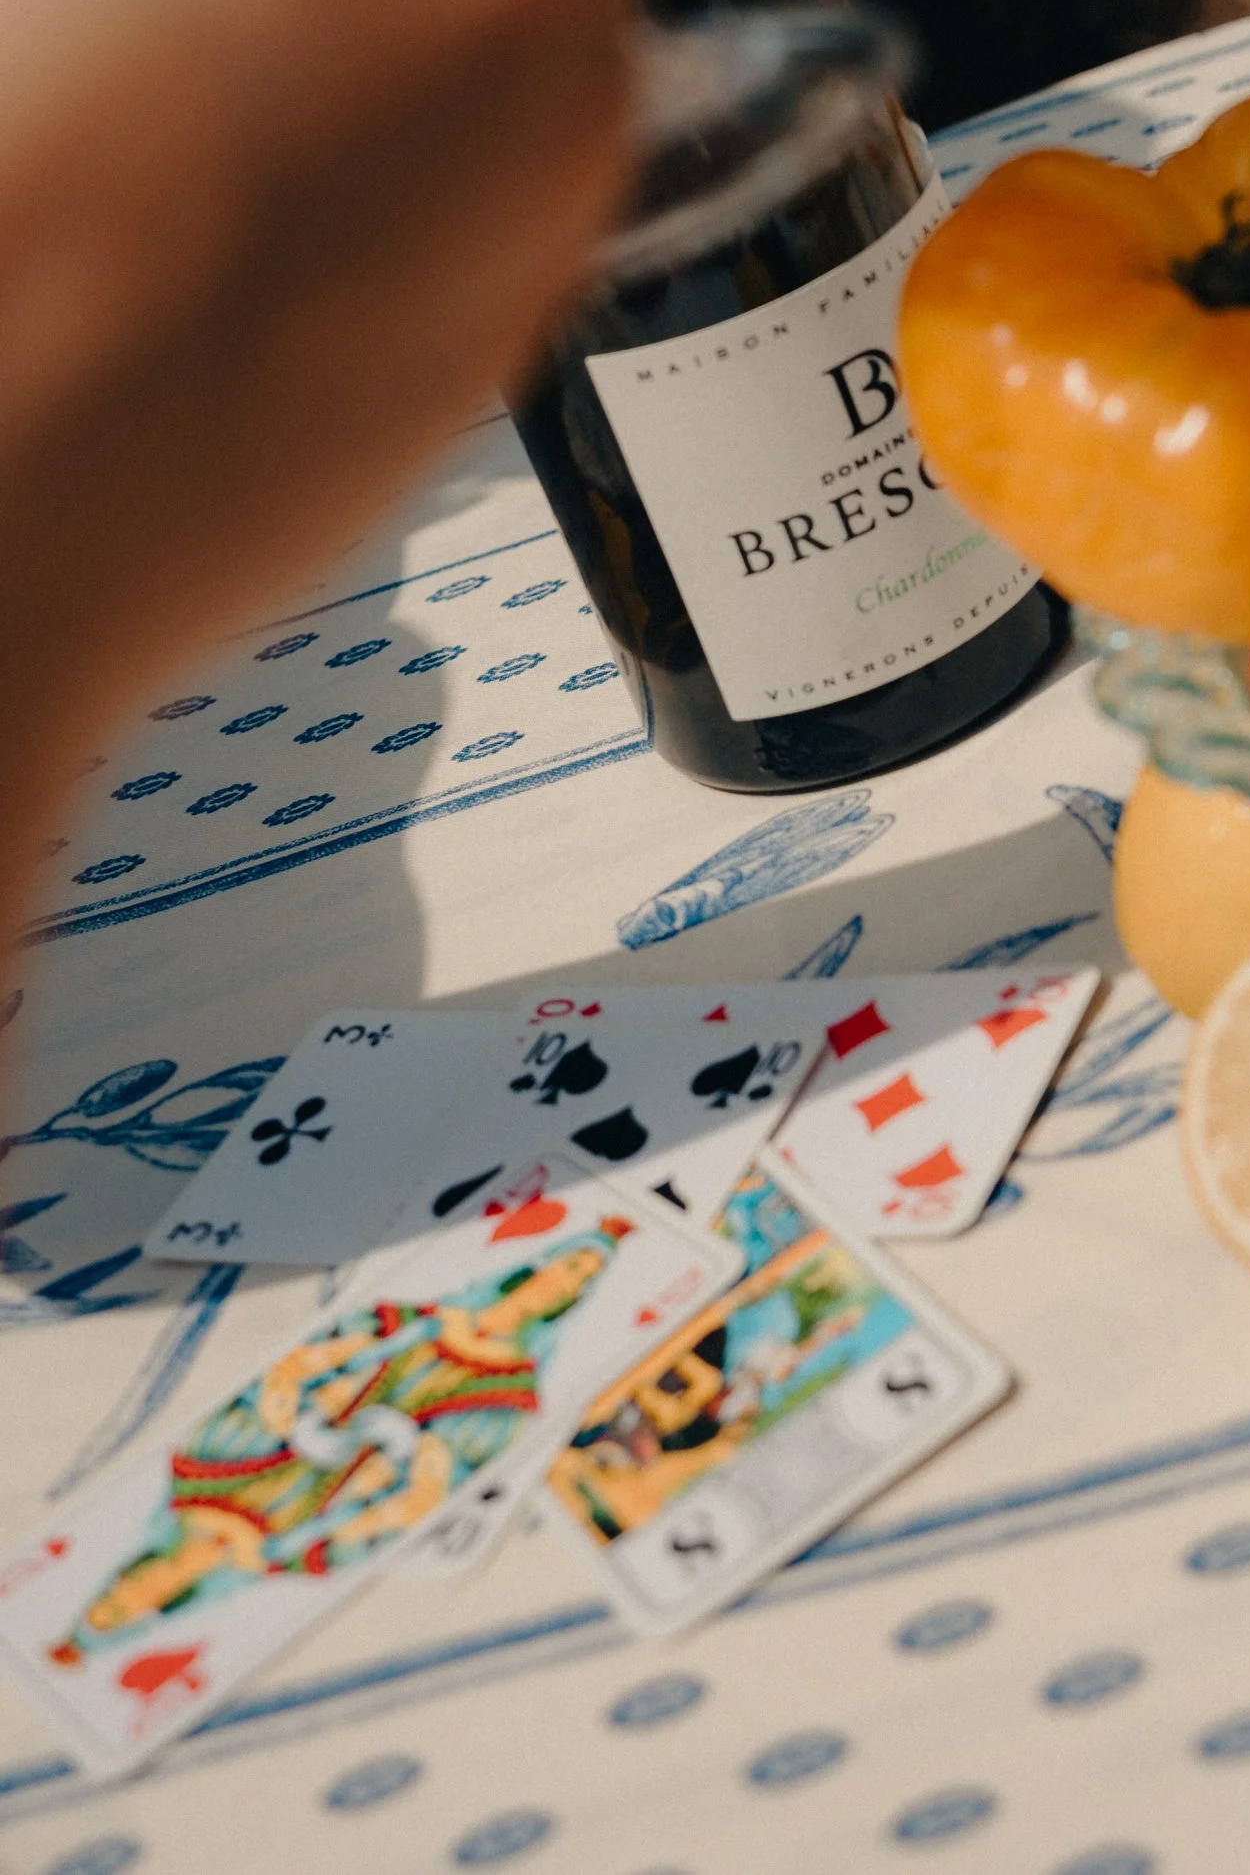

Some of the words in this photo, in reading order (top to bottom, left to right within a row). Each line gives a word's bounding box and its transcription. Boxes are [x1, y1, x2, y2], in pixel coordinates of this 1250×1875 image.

[636, 323, 789, 383] MAISON
[765, 634, 935, 701] VIGNERONS
[952, 562, 1029, 630] DEPUIS
[522, 1031, 567, 1065] 10
